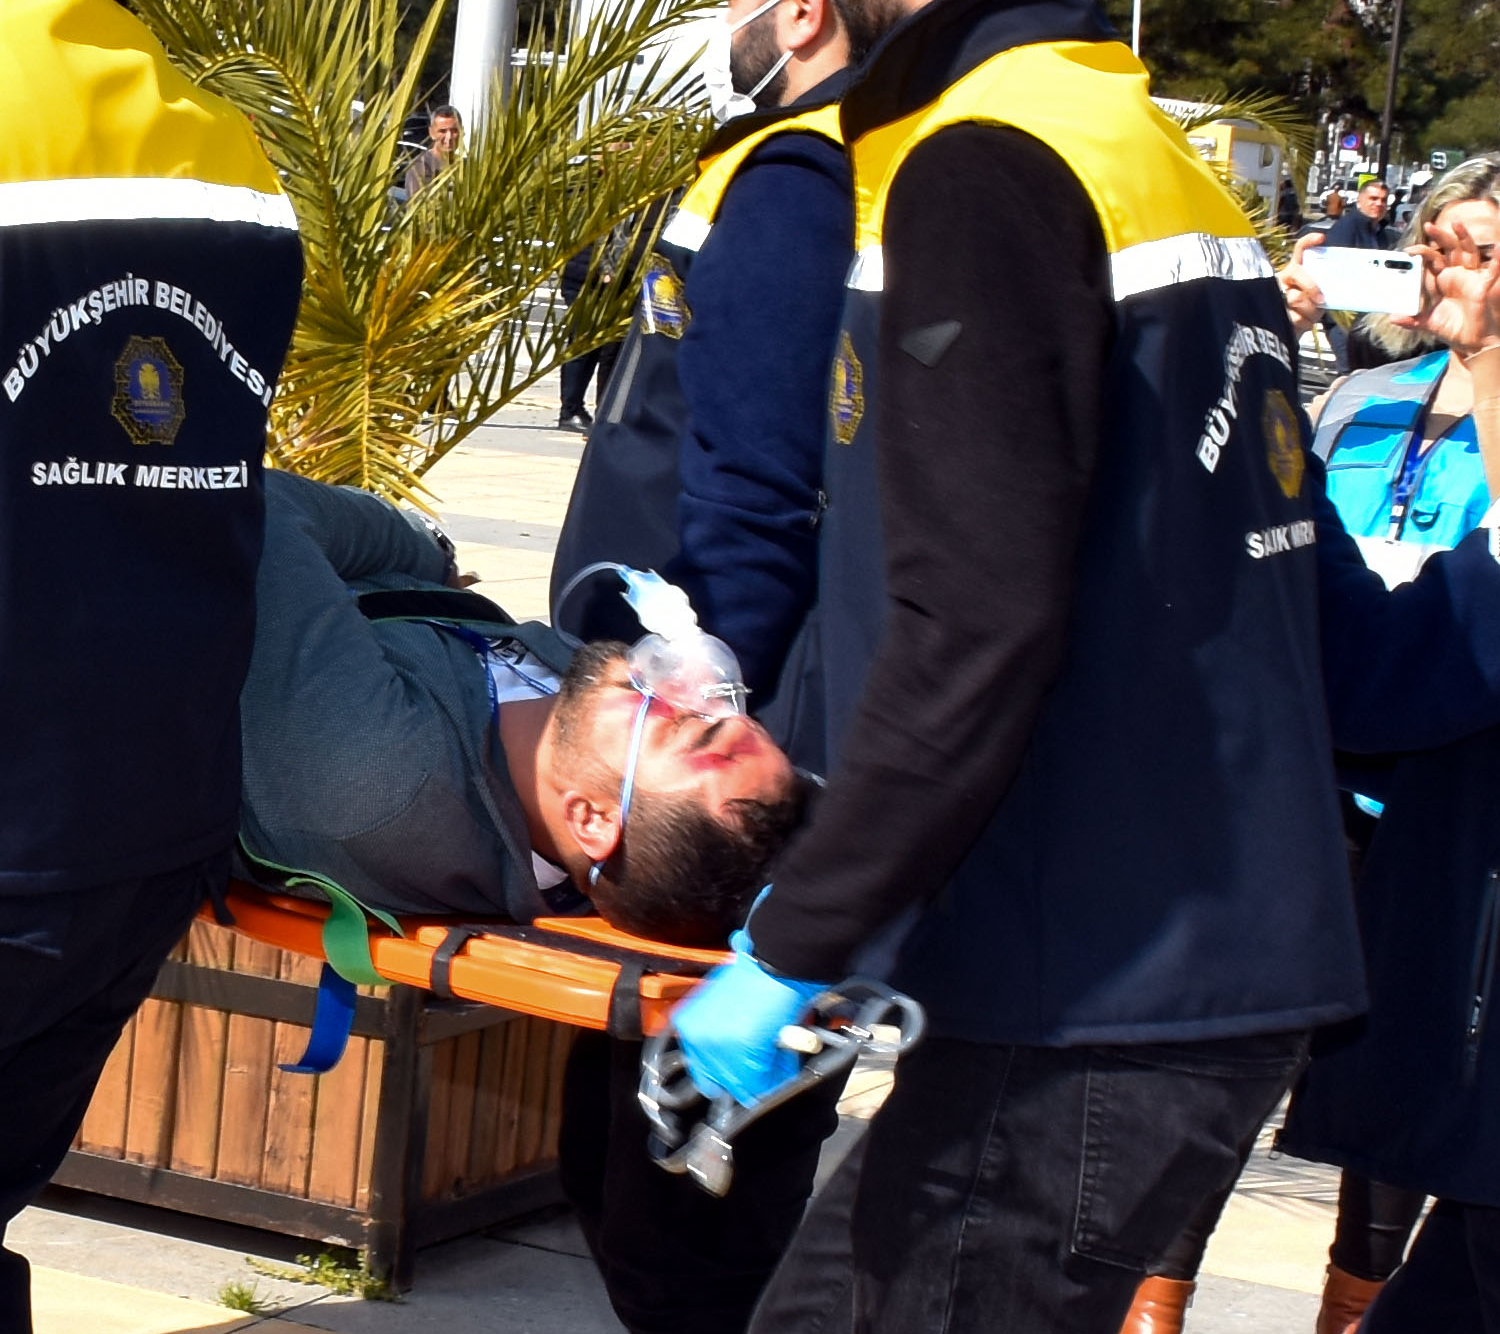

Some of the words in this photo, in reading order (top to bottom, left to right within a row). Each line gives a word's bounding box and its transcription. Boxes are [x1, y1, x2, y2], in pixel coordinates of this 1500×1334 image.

[1, 271, 150, 404] BÜYÜKŞEHİR
[30, 455, 126, 488] SAĞLIK
[135, 458, 249, 490] MERKEZİ
